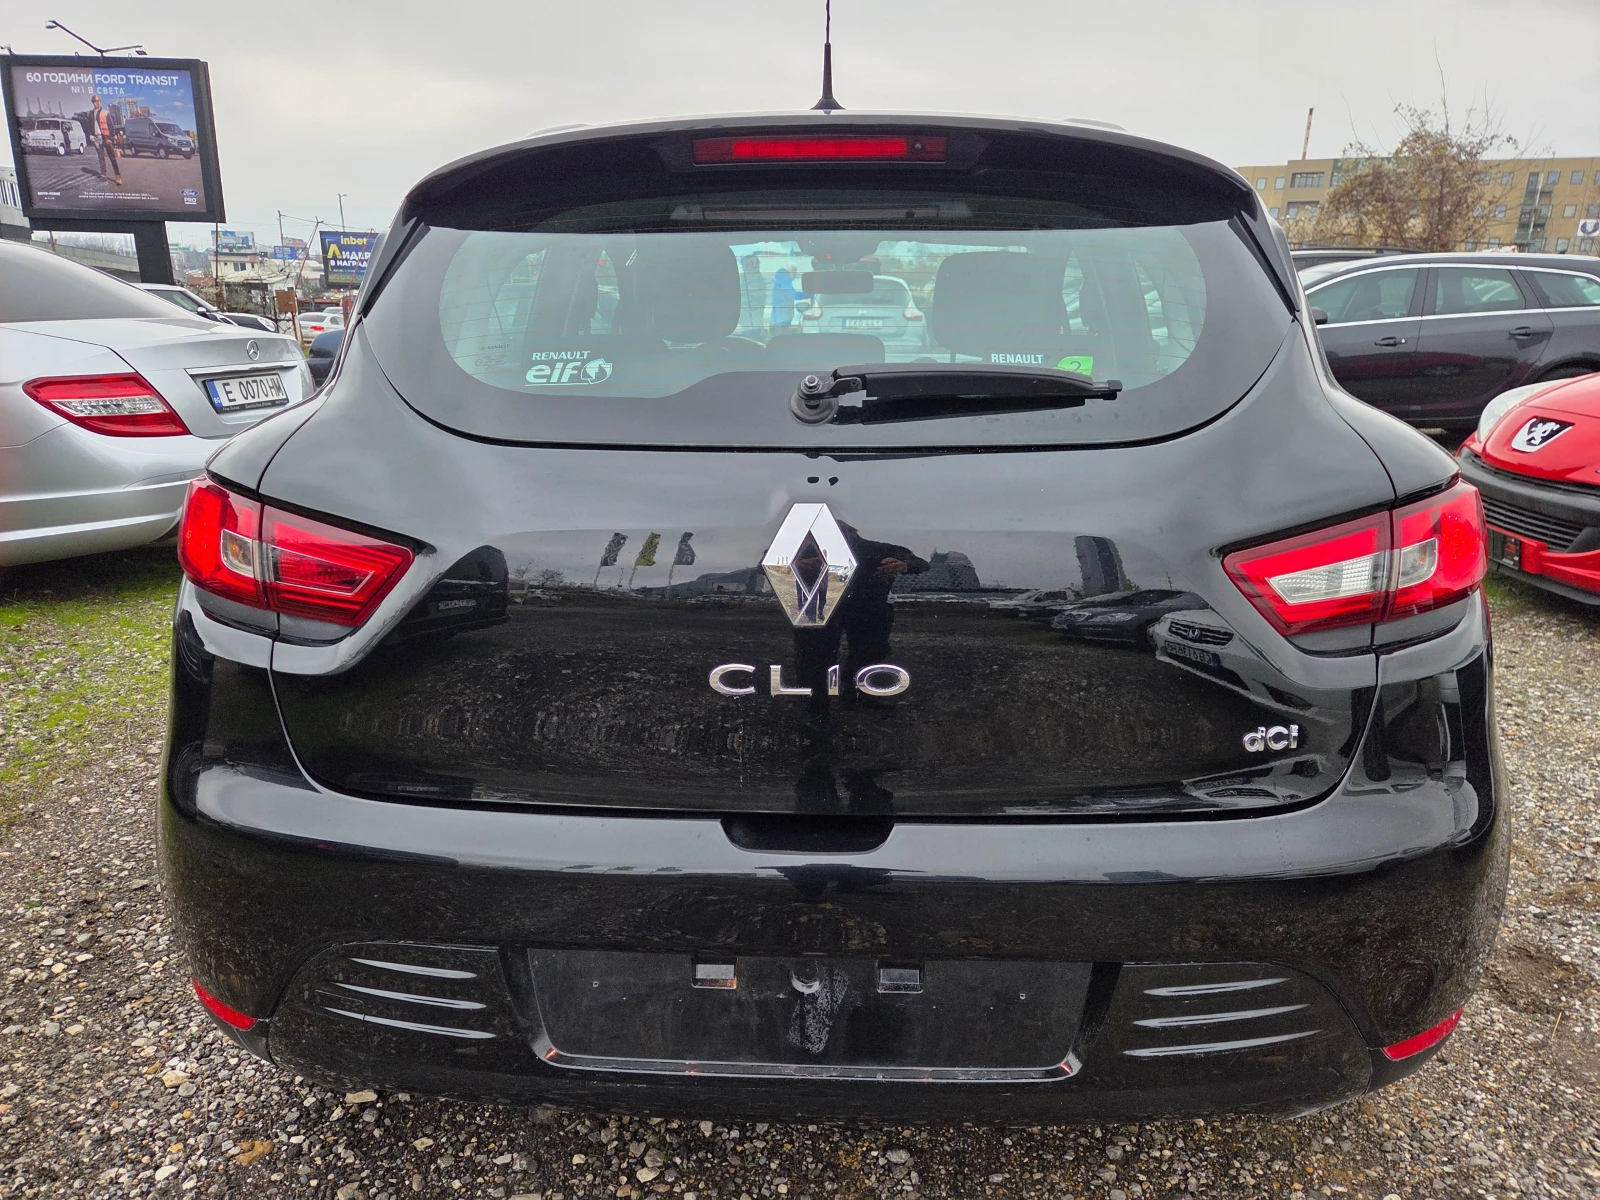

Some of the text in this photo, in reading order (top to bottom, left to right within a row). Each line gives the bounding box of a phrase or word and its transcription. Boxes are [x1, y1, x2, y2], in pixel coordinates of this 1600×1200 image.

[26, 72, 179, 86] 60 ГОДИНИ FORD TRANSIT
[532, 351, 590, 361] RENAULT
[991, 353, 1043, 364] RENAULT
[525, 361, 581, 383] elf
[222, 382, 236, 403] E
[709, 663, 910, 696] CLIO
